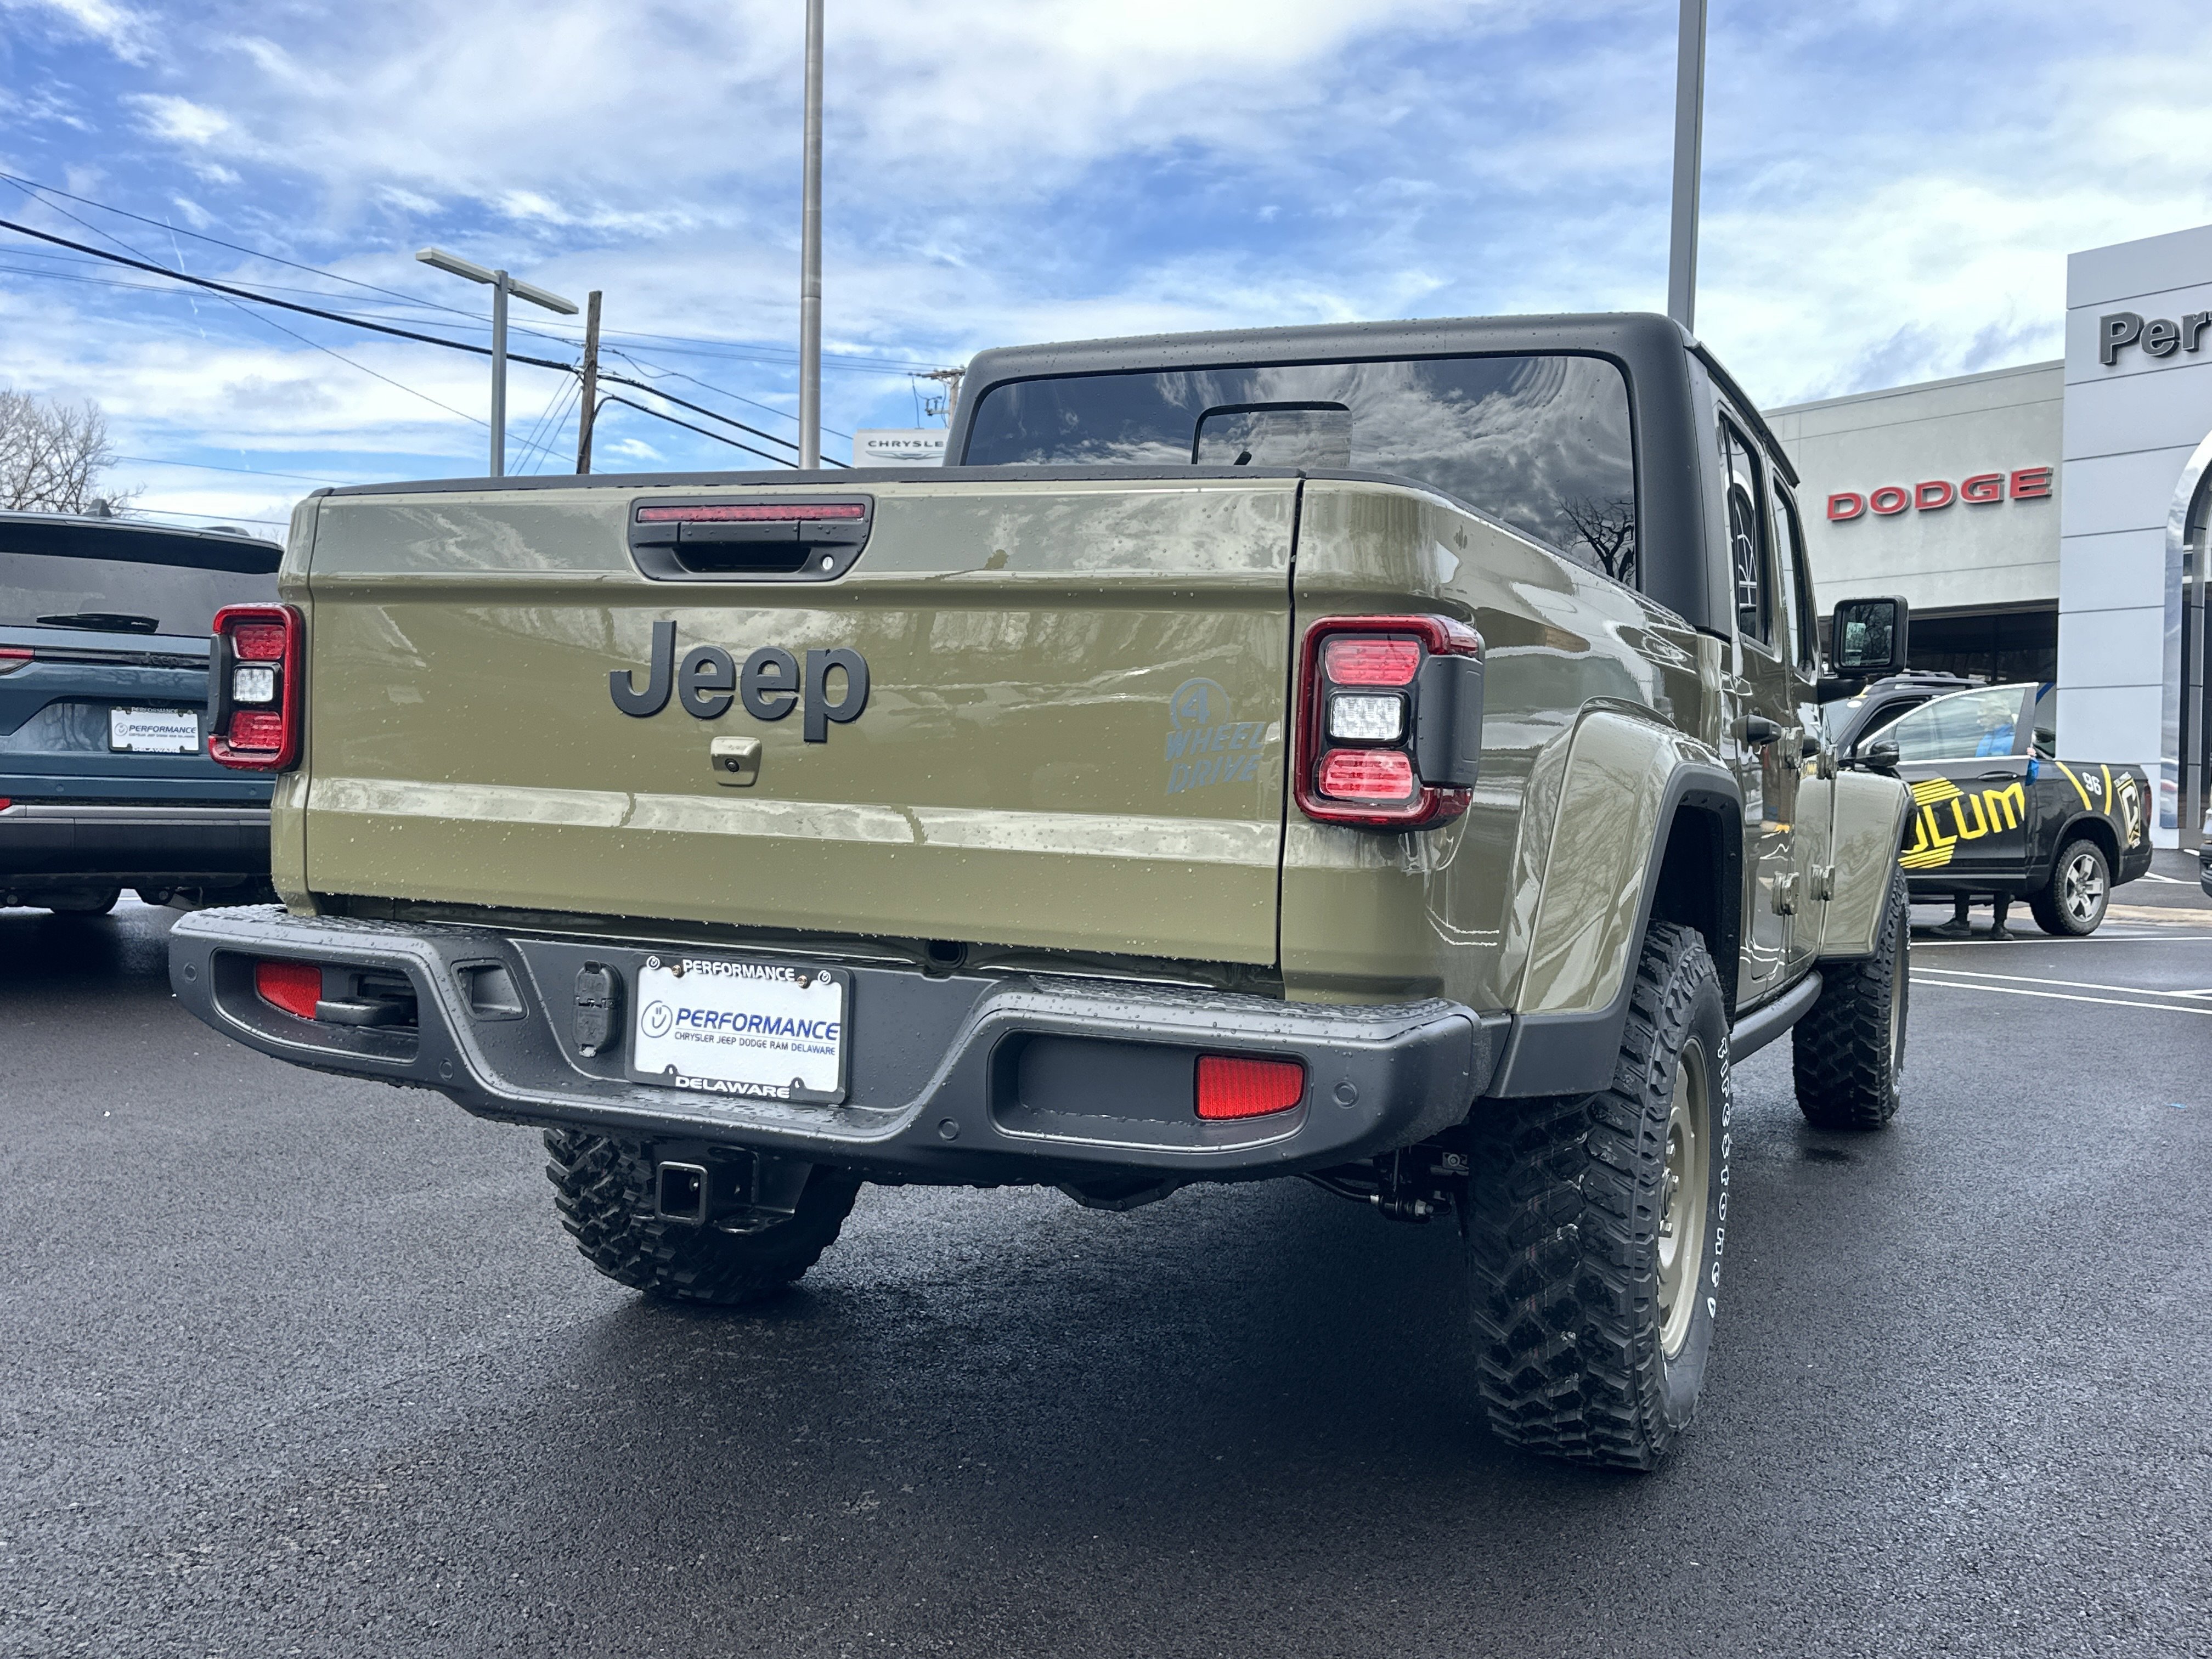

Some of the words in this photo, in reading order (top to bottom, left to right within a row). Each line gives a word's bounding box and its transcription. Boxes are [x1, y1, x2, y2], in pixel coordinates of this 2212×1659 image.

[2099, 311, 2212, 366] Per
[1827, 466, 2053, 522] DODGE
[610, 620, 871, 743] Jeep
[1181, 686, 1211, 725] 4
[129, 724, 196, 734] PERFORMANCE
[1166, 723, 1265, 762] WHEEL
[1167, 754, 1264, 795] DRIVE
[683, 958, 795, 981] PERFORMANCE
[674, 1031, 714, 1043] CHRYSLER
[716, 1035, 736, 1045] JEEP
[739, 1037, 767, 1048] DODGE
[770, 1041, 788, 1051] RAM
[791, 1043, 836, 1056] DELAWARE
[675, 1007, 840, 1041] PERFORMANCE
[675, 1076, 790, 1099] DELAWARE
